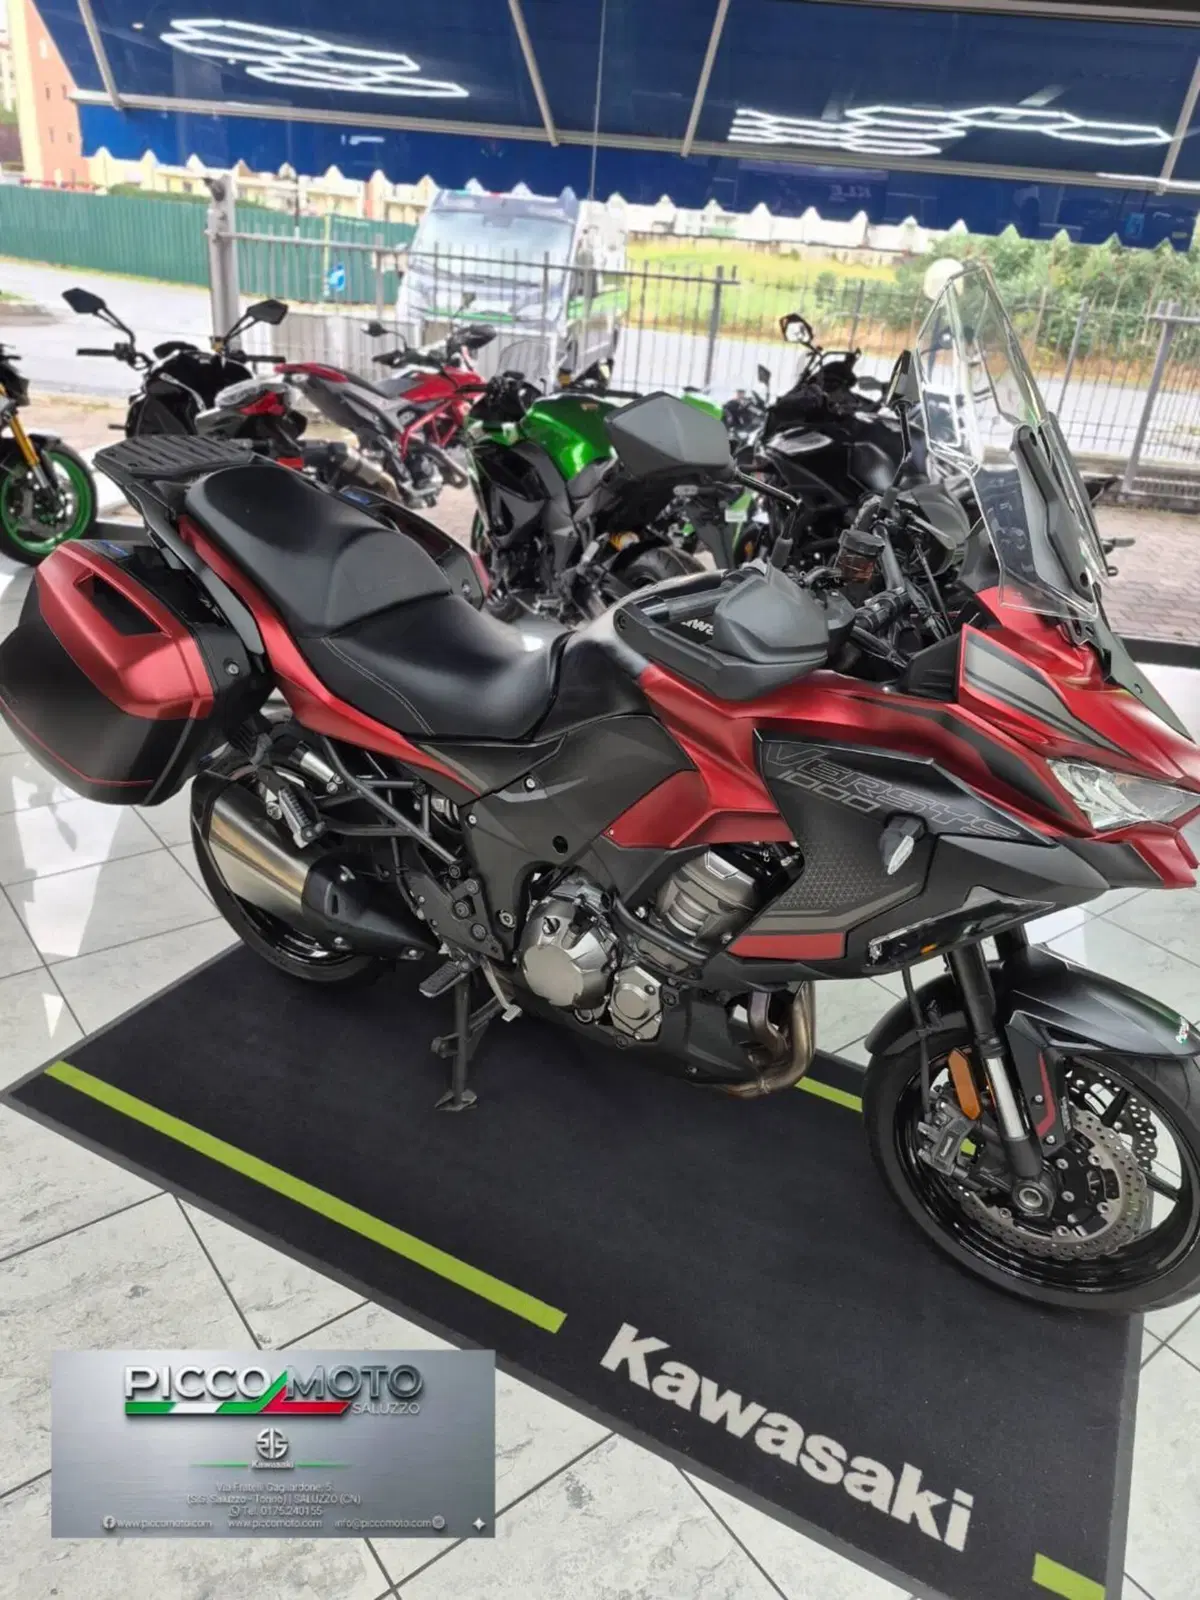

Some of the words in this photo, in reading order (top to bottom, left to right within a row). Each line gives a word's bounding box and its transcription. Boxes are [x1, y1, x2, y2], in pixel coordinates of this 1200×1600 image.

[766, 742, 1020, 838] VERSYS
[777, 770, 881, 813] 1000
[600, 1322, 974, 1552] Kawasaki
